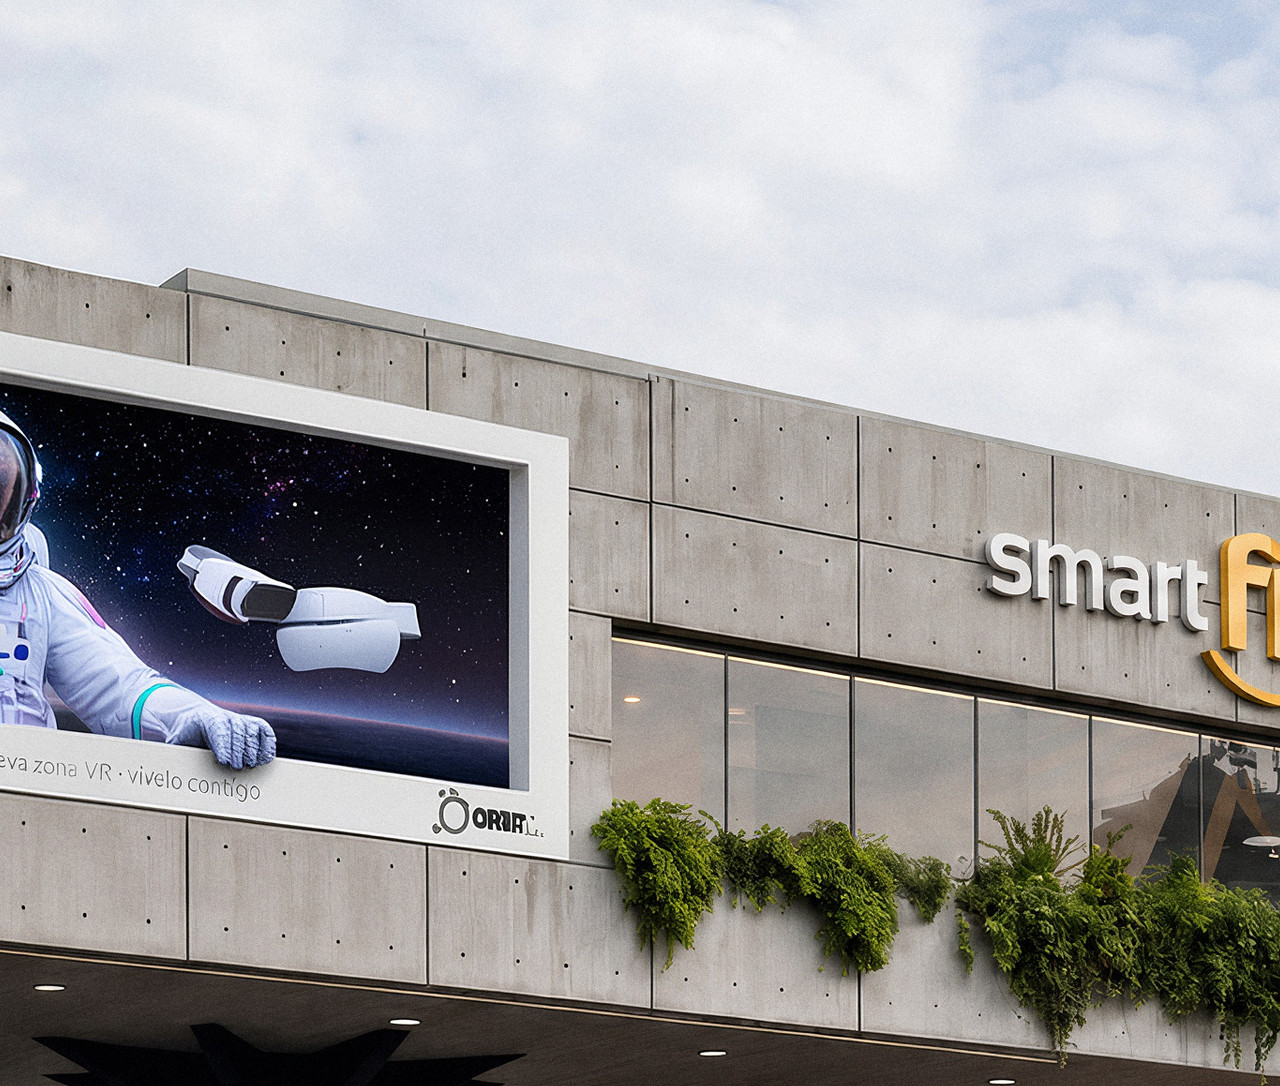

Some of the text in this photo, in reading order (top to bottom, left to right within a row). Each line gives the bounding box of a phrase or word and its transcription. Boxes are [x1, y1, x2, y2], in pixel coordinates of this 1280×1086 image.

[984, 532, 1209, 632] smart
[32, 760, 77, 778] zona
[85, 761, 112, 781] VR
[127, 766, 183, 790] vivelo
